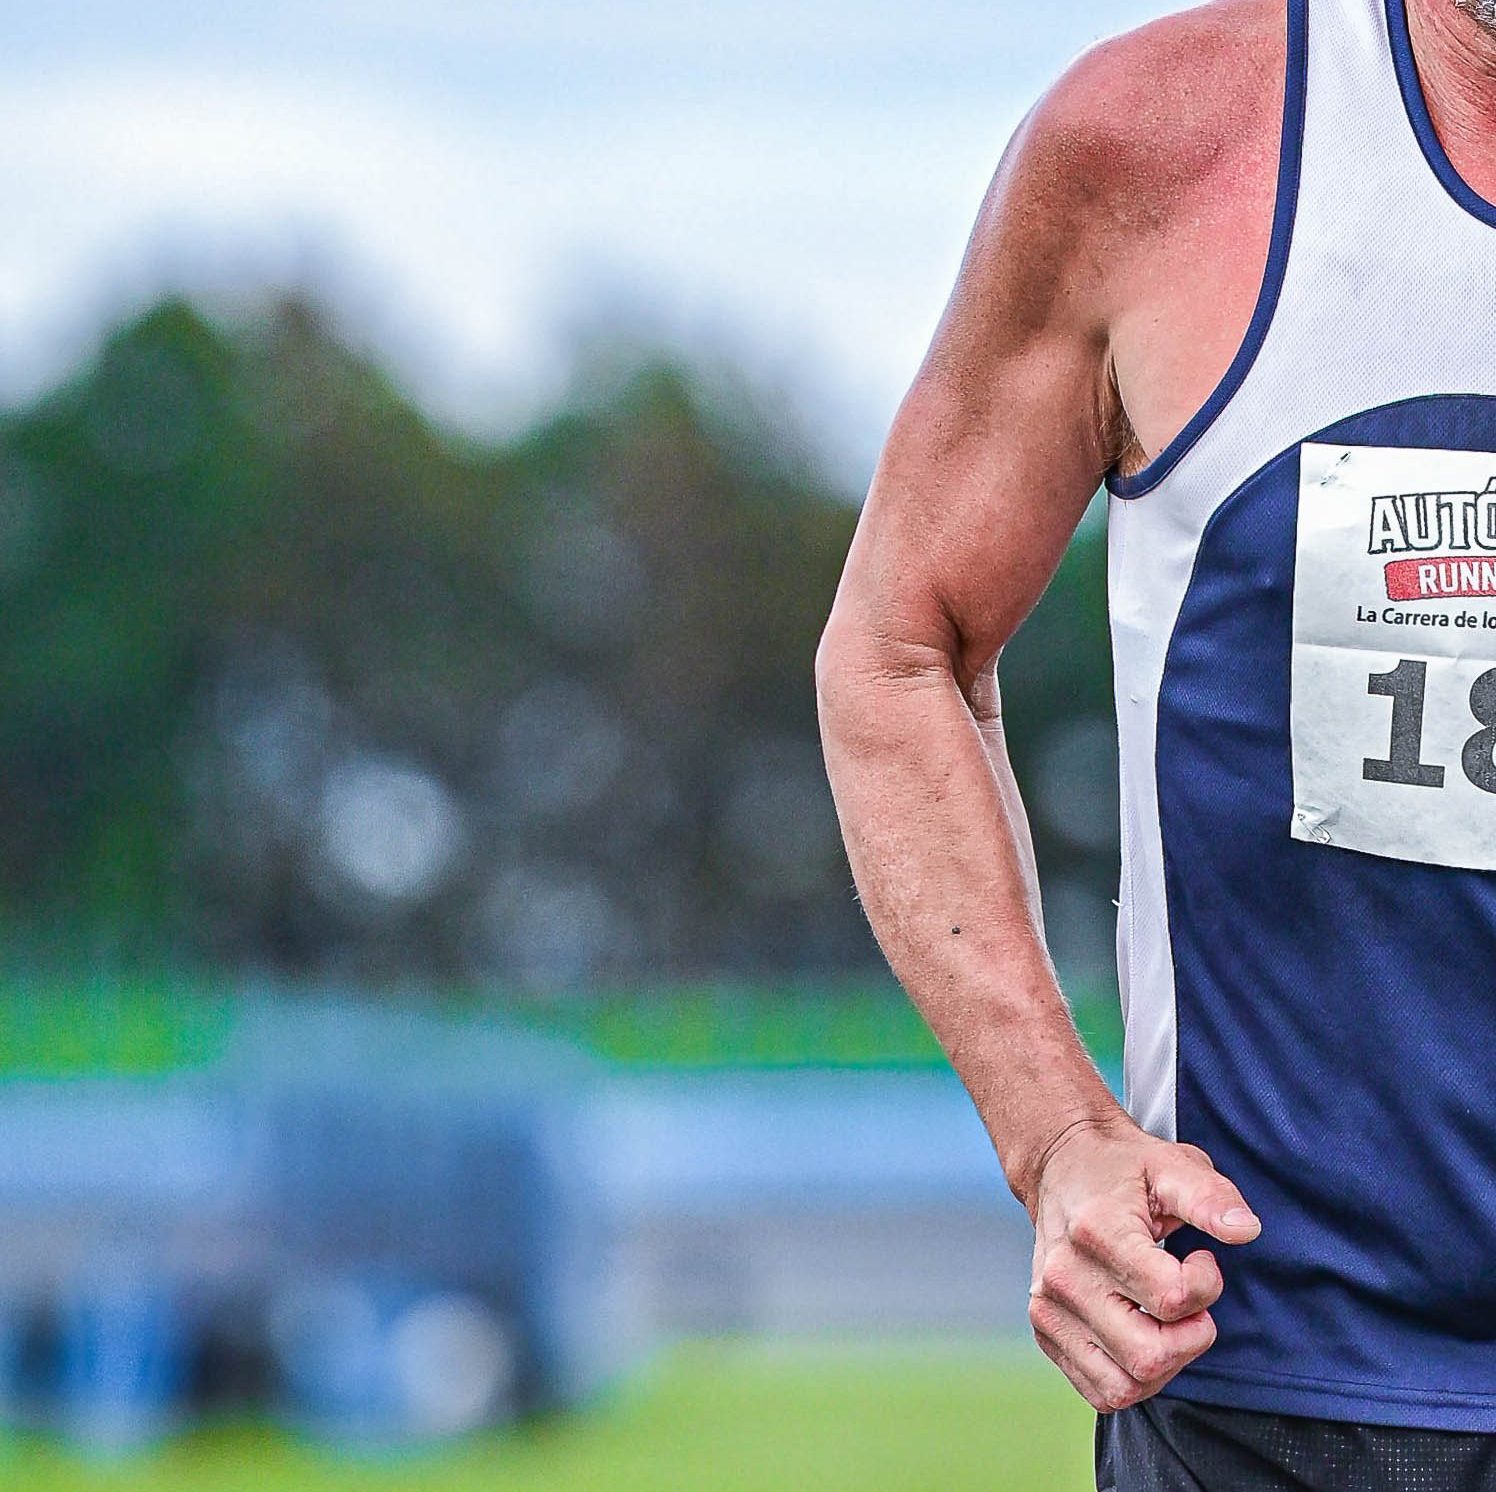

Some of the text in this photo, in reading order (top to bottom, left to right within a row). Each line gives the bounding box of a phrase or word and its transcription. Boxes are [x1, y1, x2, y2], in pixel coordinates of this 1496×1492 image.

[1356, 605, 1377, 623] La
[1382, 607, 1449, 627] Carrera
[1454, 610, 1478, 629] de
